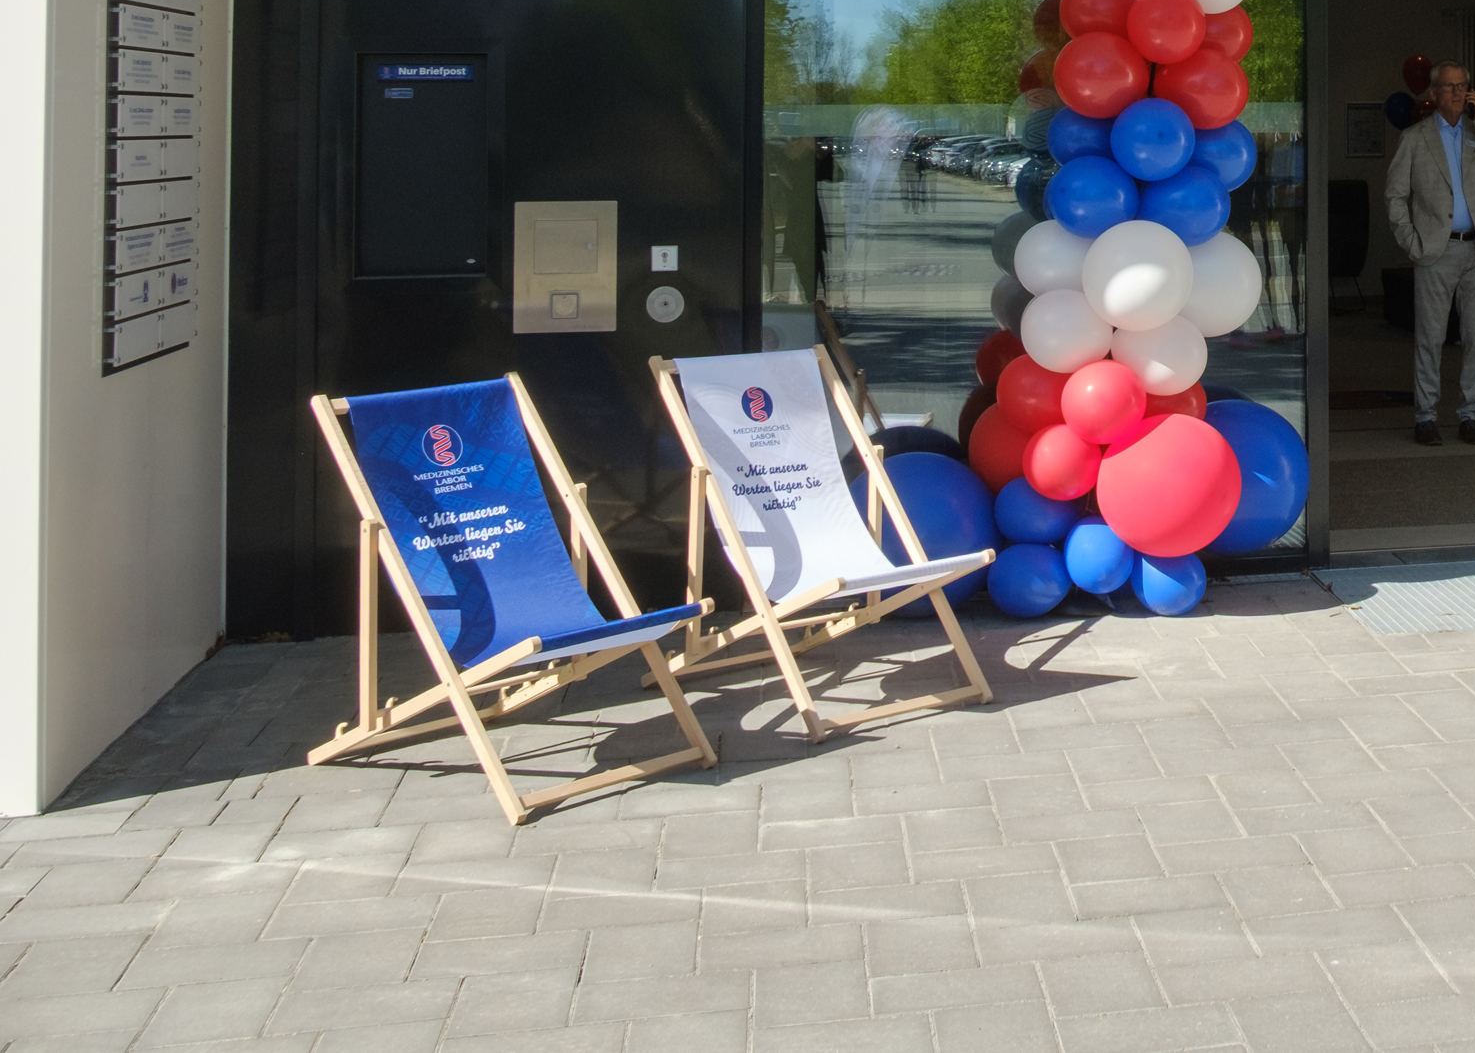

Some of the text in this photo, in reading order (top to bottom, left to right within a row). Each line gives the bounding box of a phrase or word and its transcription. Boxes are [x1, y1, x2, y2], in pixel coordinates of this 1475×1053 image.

[398, 66, 467, 77] Nur Briefpost
[733, 424, 790, 435] MEDIZINISCHES
[751, 432, 776, 441] LABOR
[750, 439, 780, 448] BREMEN
[413, 463, 484, 481] MEDIZINISCHES
[769, 462, 808, 475] unseren
[435, 475, 467, 487] LABOR
[732, 477, 822, 496] Werten liegen Sie
[434, 482, 472, 495] BREMEN
[458, 504, 509, 521] unseren
[412, 518, 526, 551] Werten liegen Sie
